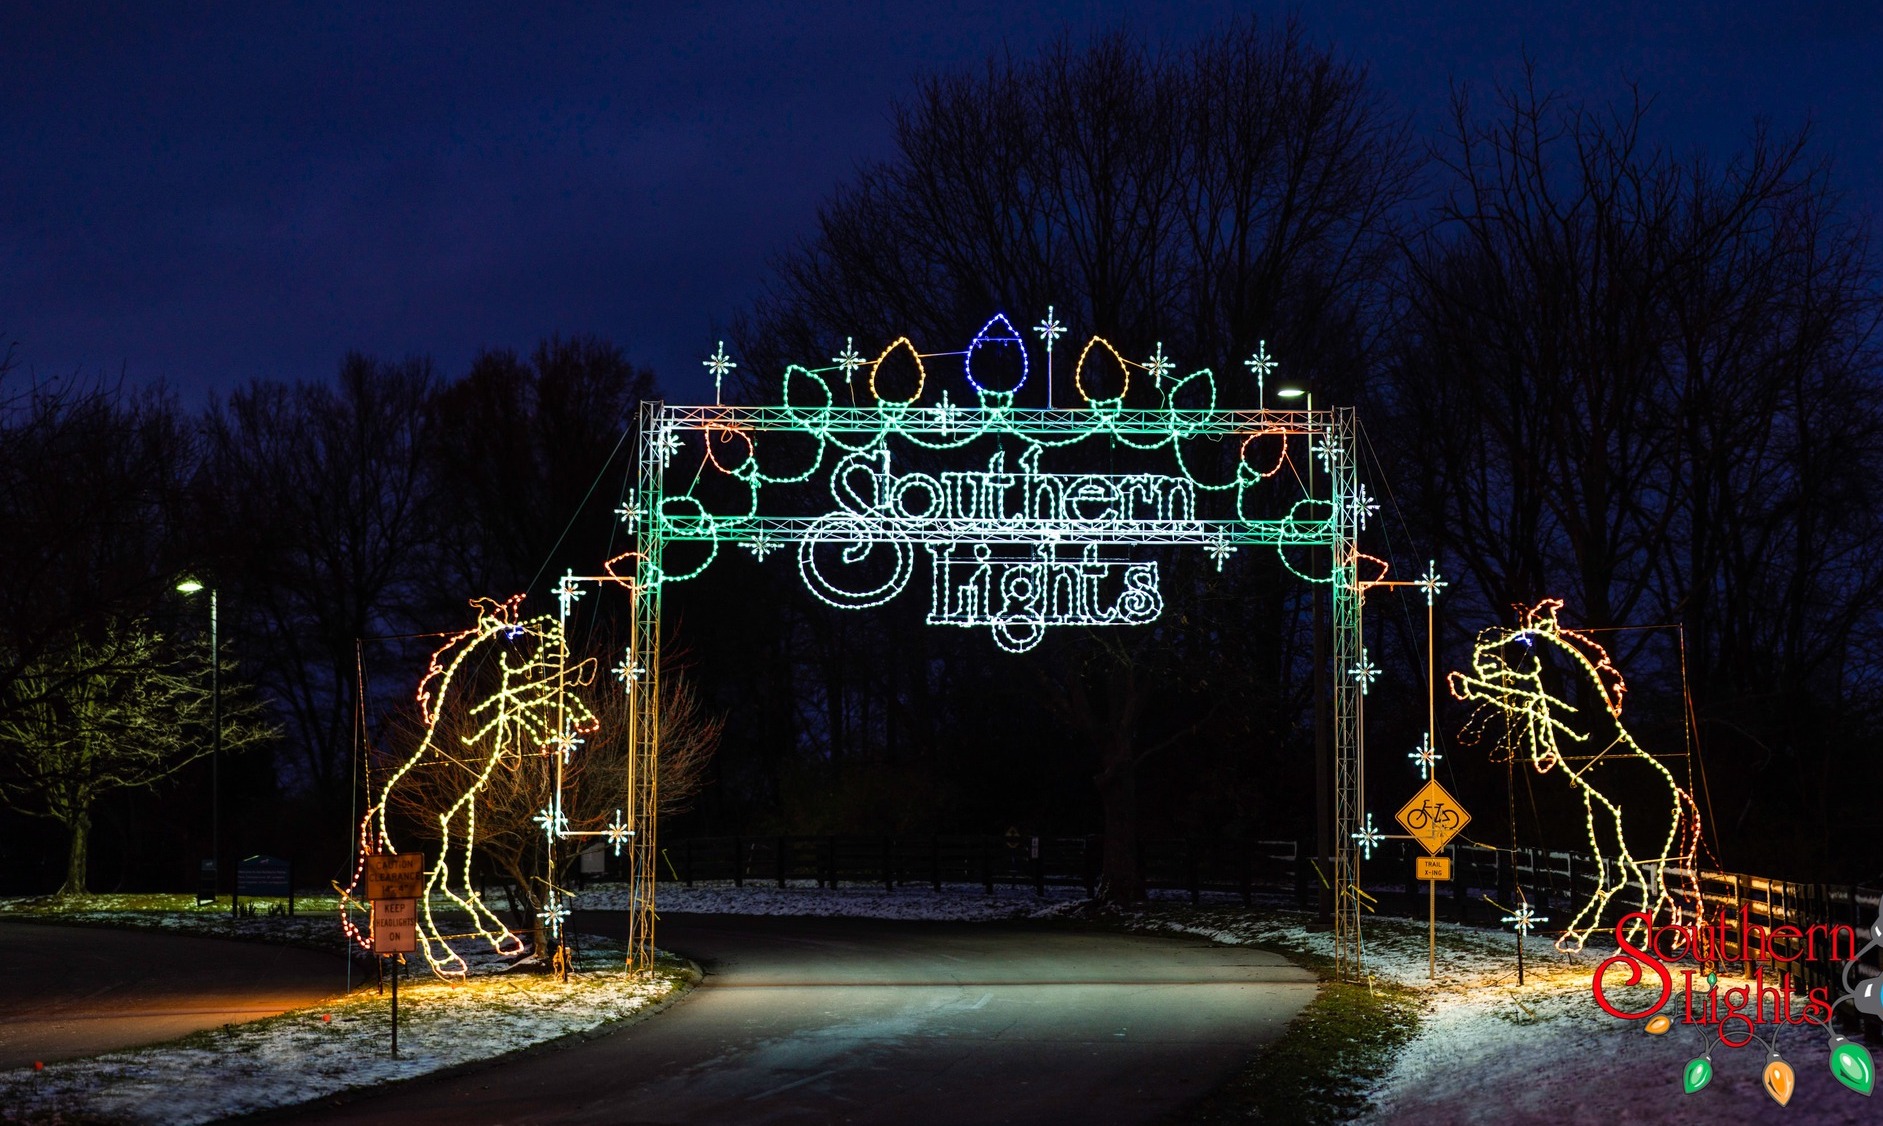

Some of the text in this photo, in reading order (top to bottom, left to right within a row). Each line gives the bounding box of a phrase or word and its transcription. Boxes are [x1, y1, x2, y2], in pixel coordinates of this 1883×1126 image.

[799, 443, 1203, 609] Southern
[926, 530, 1164, 653] Lights
[376, 860, 413, 869] CAUTION
[369, 872, 420, 882] CLEARANCE
[384, 904, 405, 913] KEEP
[376, 917, 414, 927] HEADLIGHTS
[389, 932, 401, 941] ON
